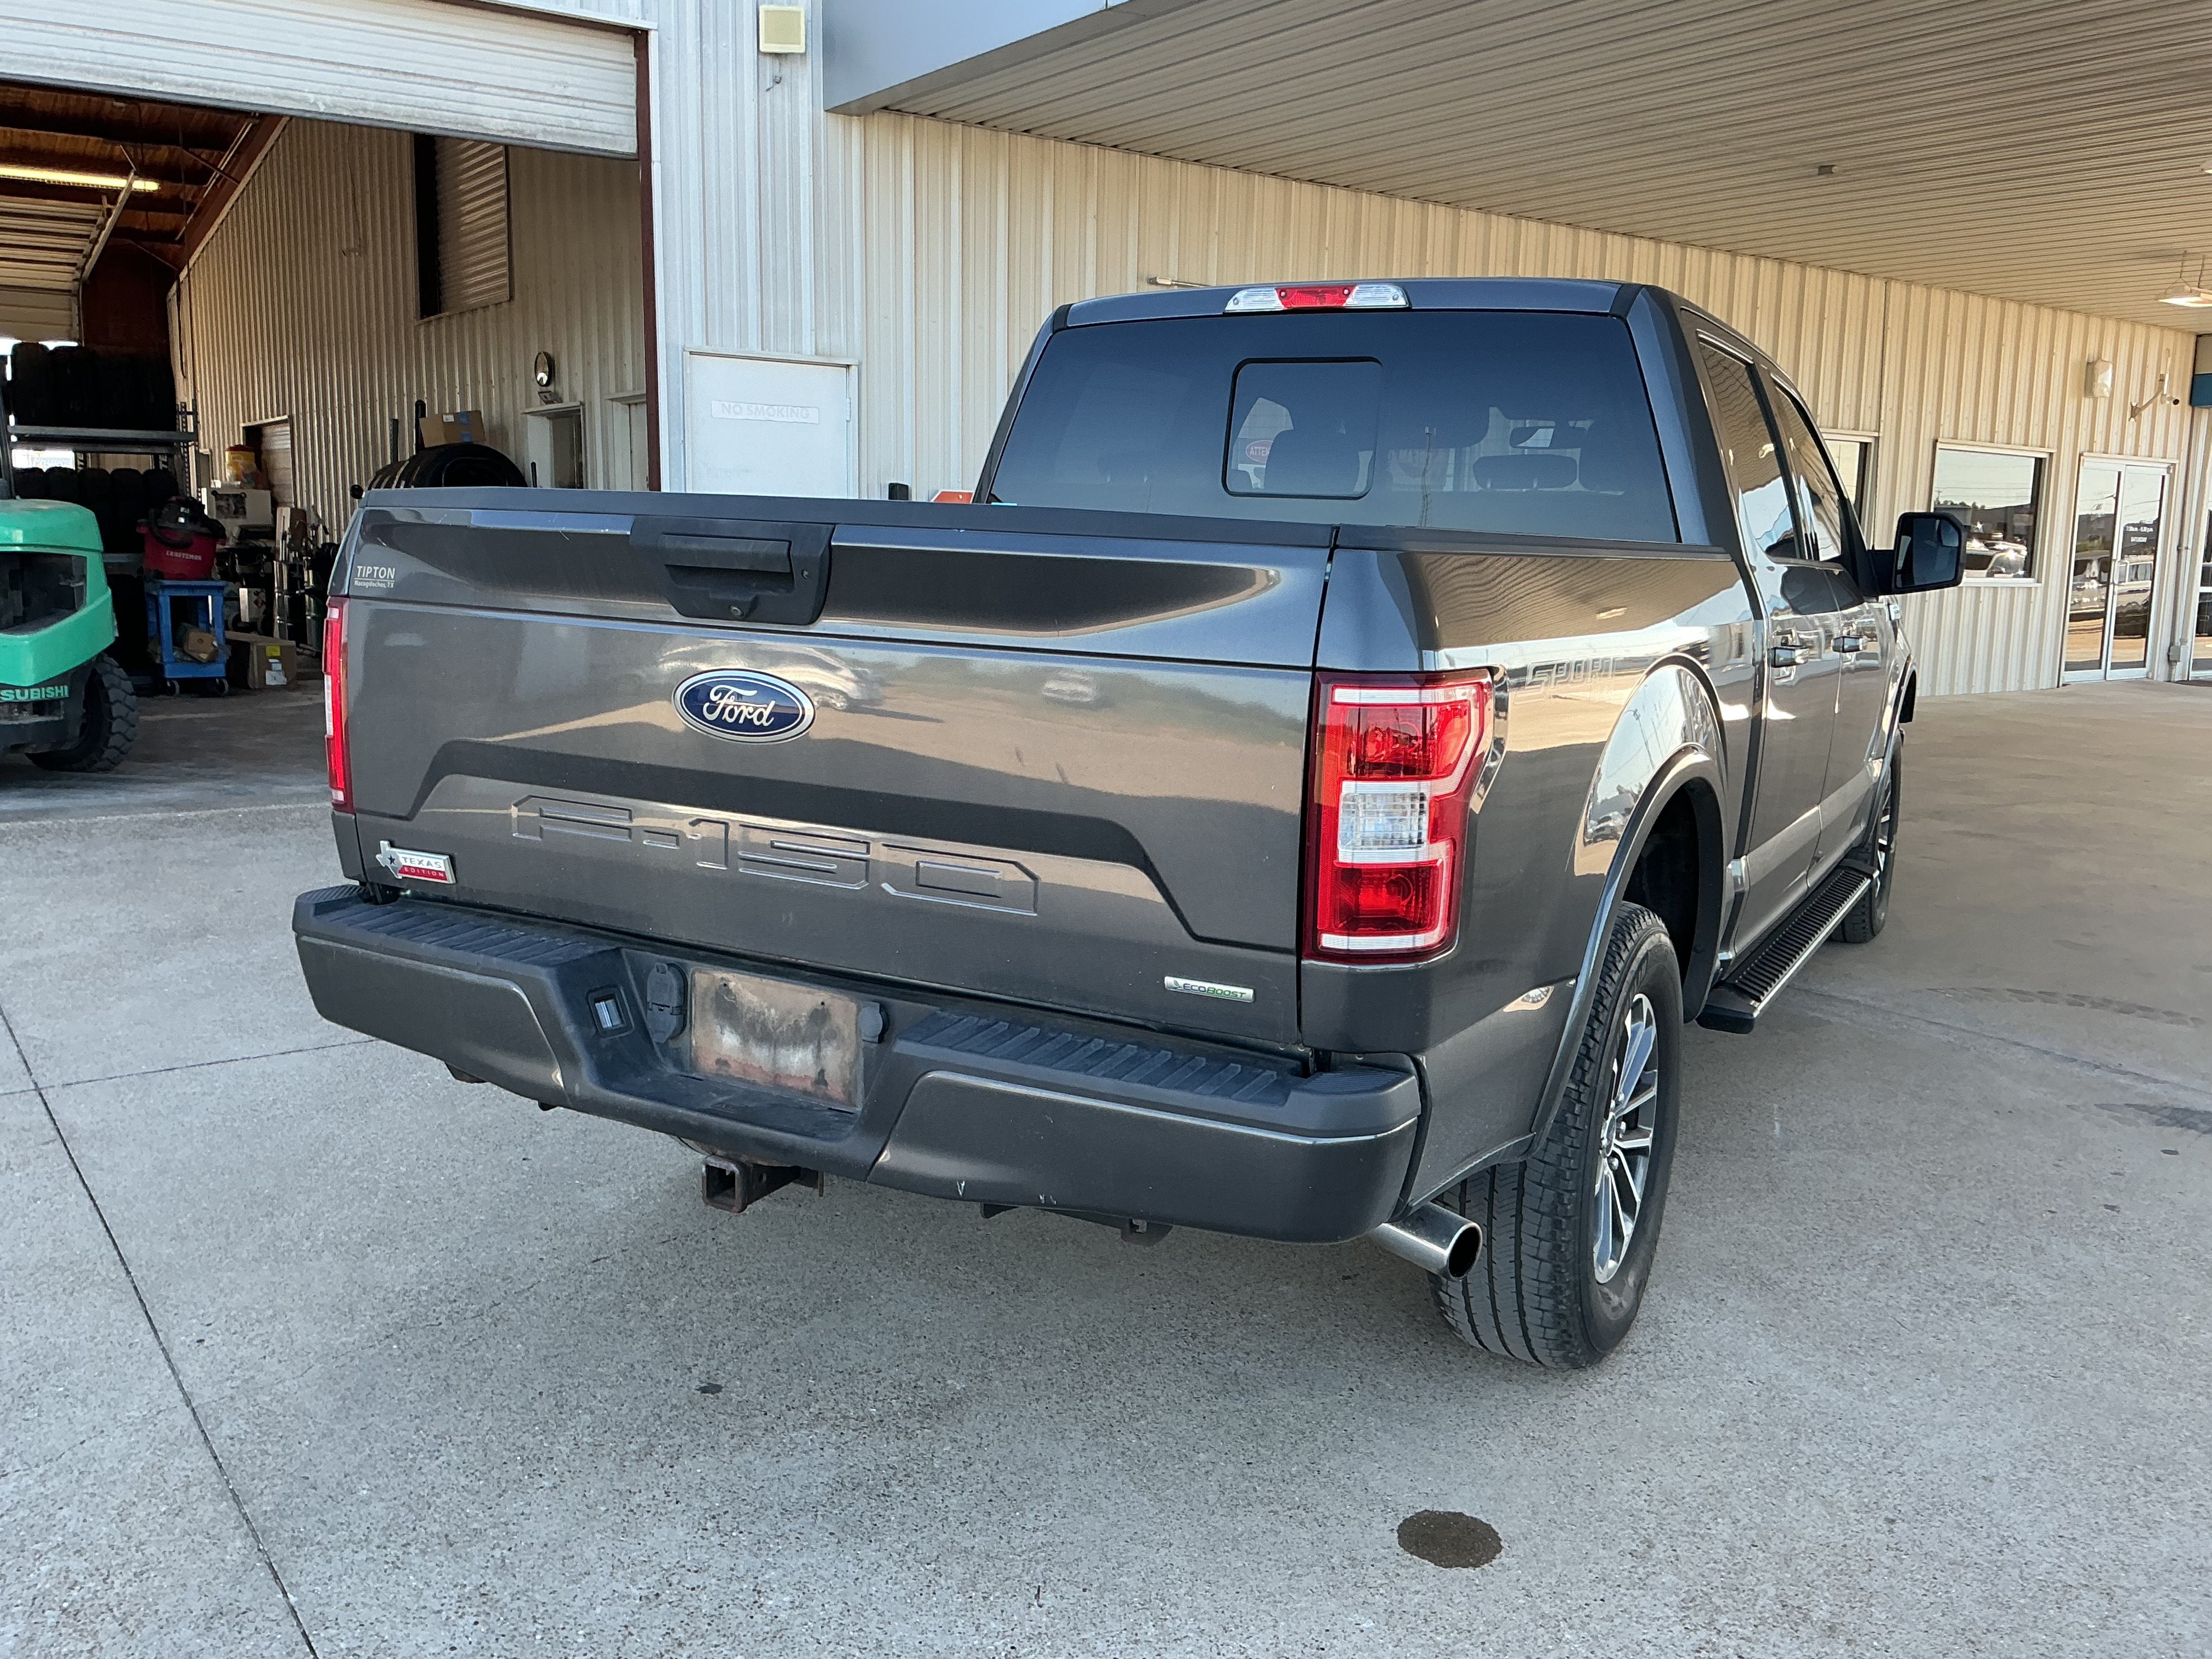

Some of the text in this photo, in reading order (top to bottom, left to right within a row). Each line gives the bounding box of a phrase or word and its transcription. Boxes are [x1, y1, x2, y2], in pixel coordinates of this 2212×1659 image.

[721, 402, 810, 420] NO SMOKING
[357, 565, 396, 579] TIPTON
[702, 684, 777, 727] Ford
[402, 856, 442, 868] TEXAS
[511, 793, 1040, 917] F-150
[404, 866, 444, 878] EDITION
